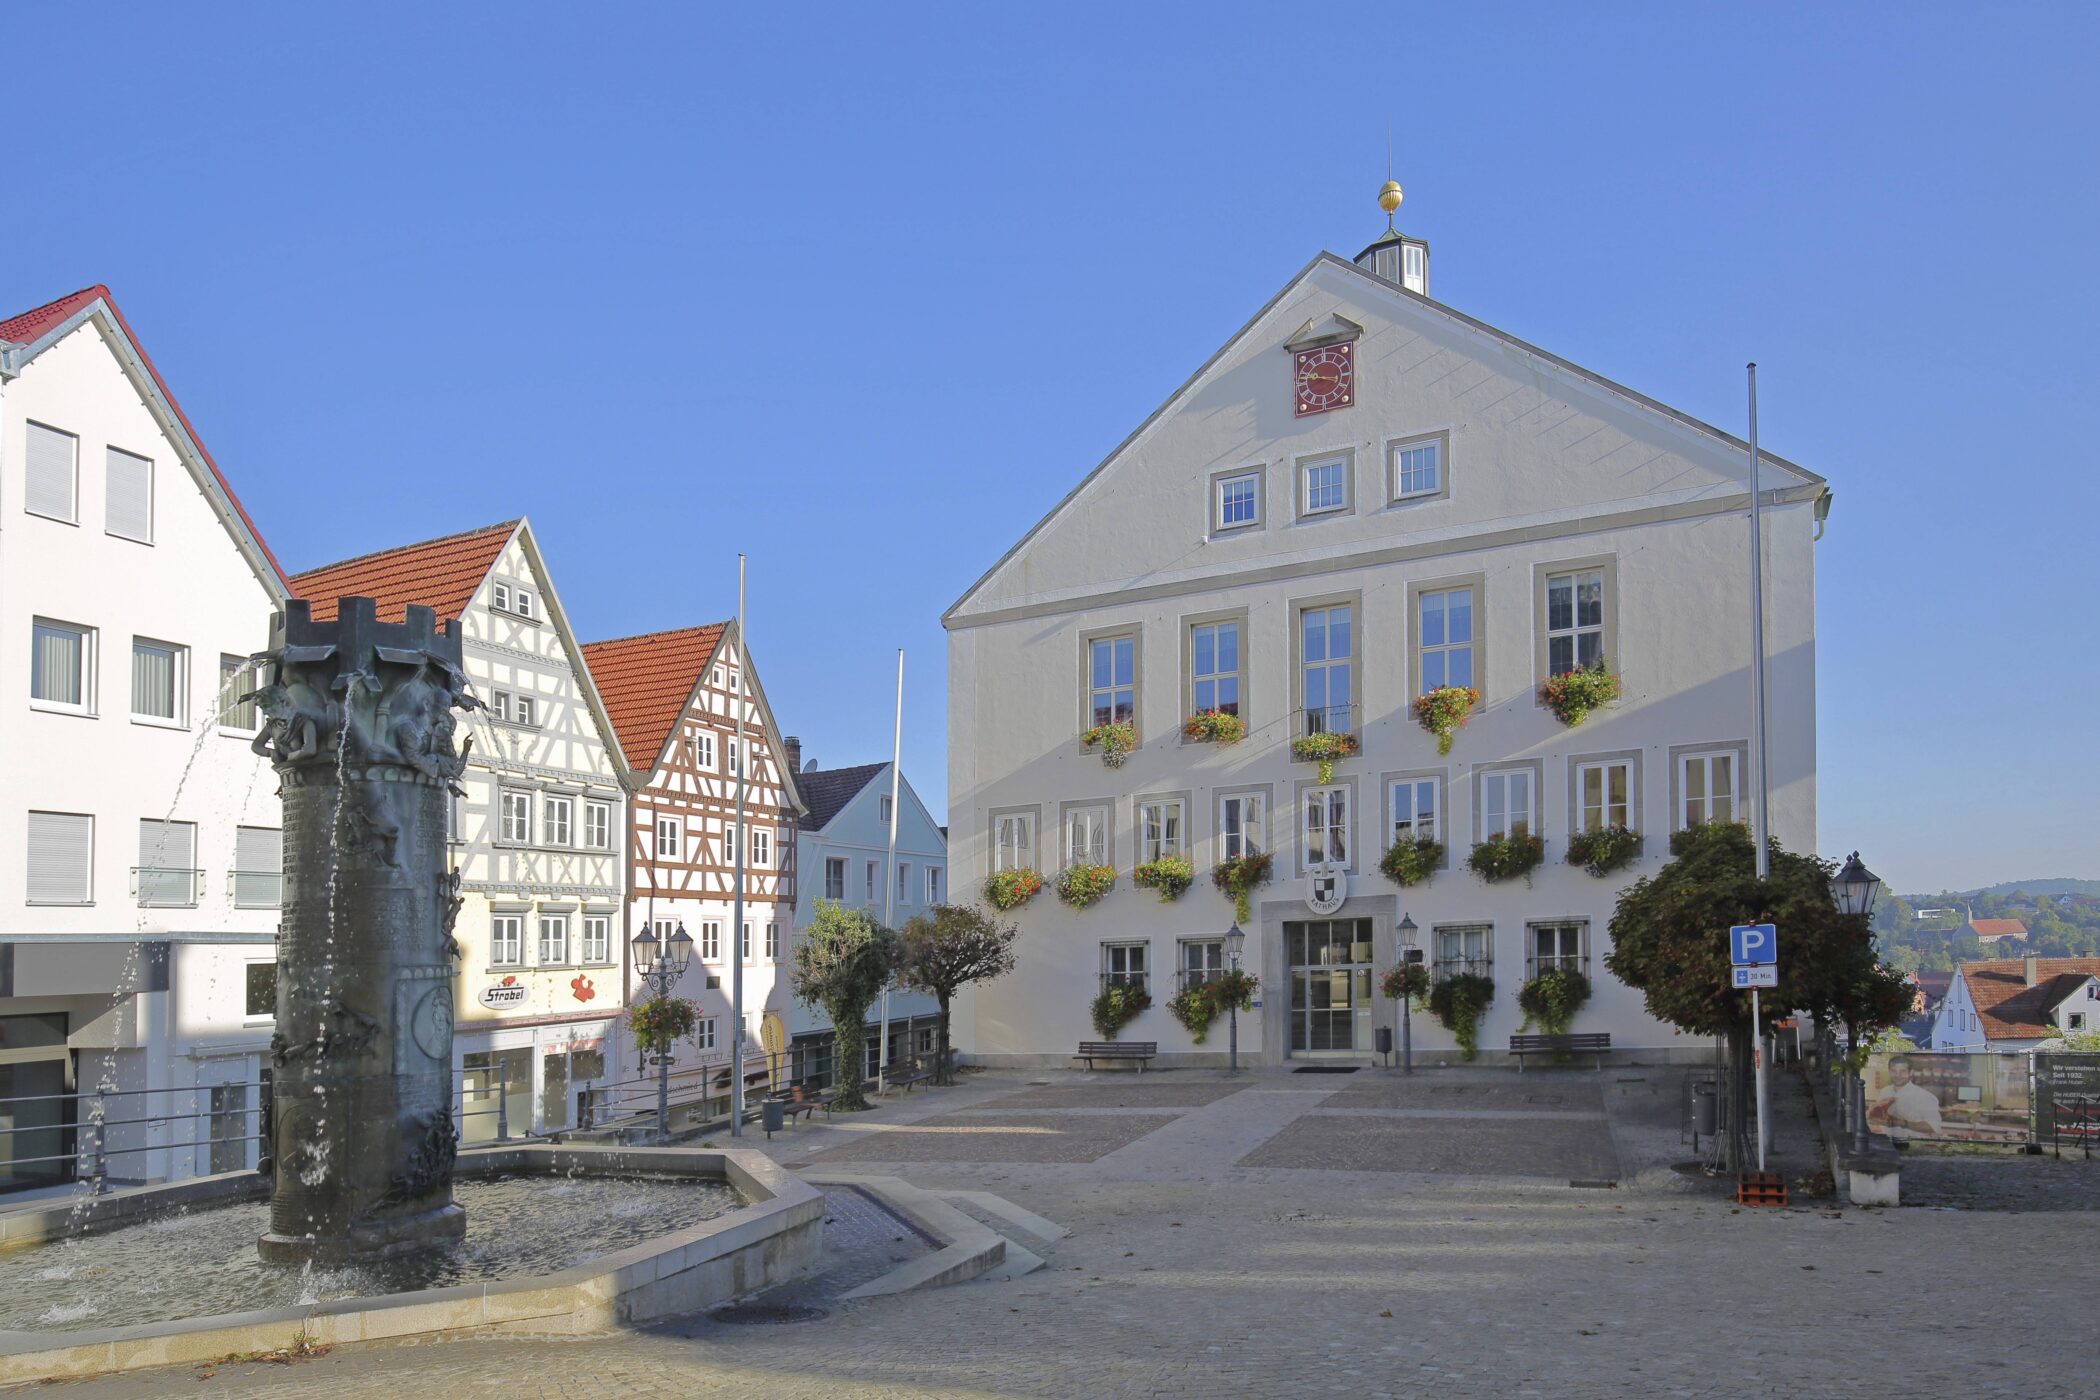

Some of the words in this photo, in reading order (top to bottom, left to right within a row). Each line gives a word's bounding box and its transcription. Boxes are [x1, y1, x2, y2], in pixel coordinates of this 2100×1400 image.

[1311, 897, 1339, 910] RATHAUS
[1741, 930, 1765, 960] P
[484, 986, 525, 1002] Strobel
